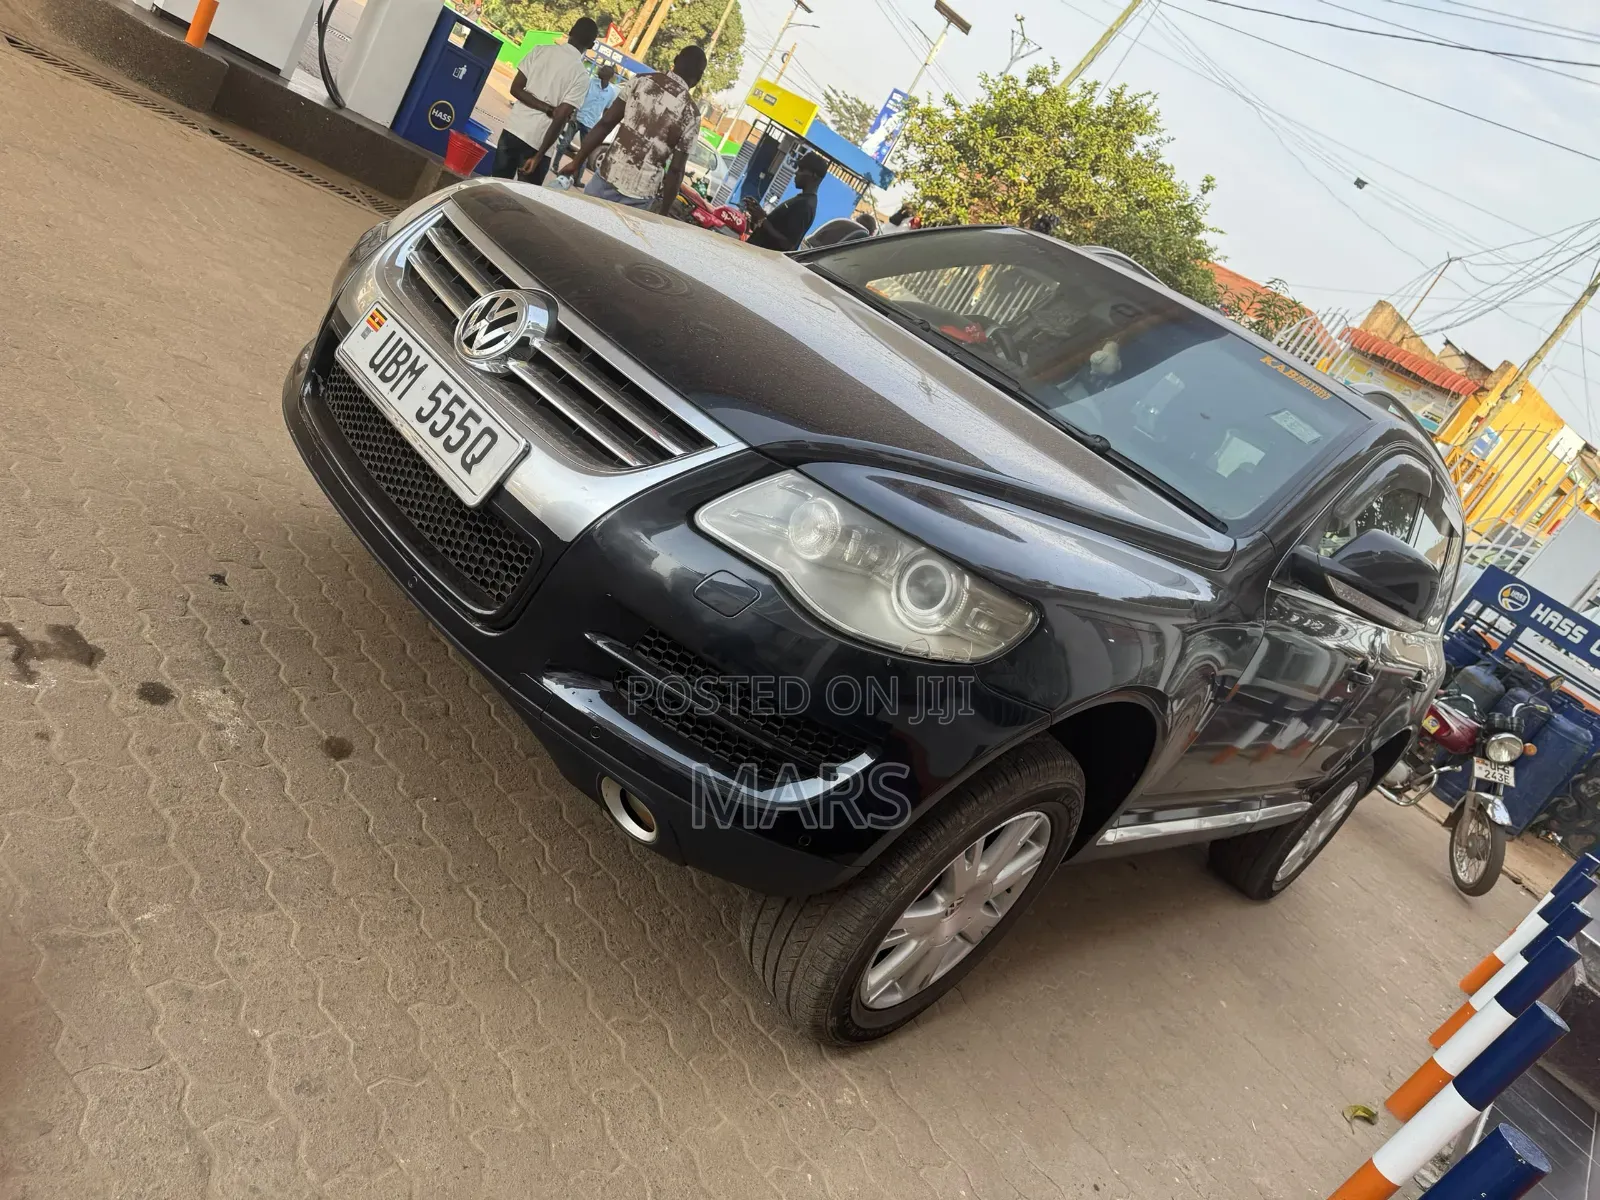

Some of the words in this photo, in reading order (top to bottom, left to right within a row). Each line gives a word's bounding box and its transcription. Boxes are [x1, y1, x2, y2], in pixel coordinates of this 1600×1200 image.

[431, 108, 452, 123] HASS
[458, 292, 526, 358] VW
[369, 330, 428, 400] UBM
[415, 380, 498, 475] 555Q
[1530, 603, 1589, 644] HASS
[1484, 770, 1510, 785] 243E
